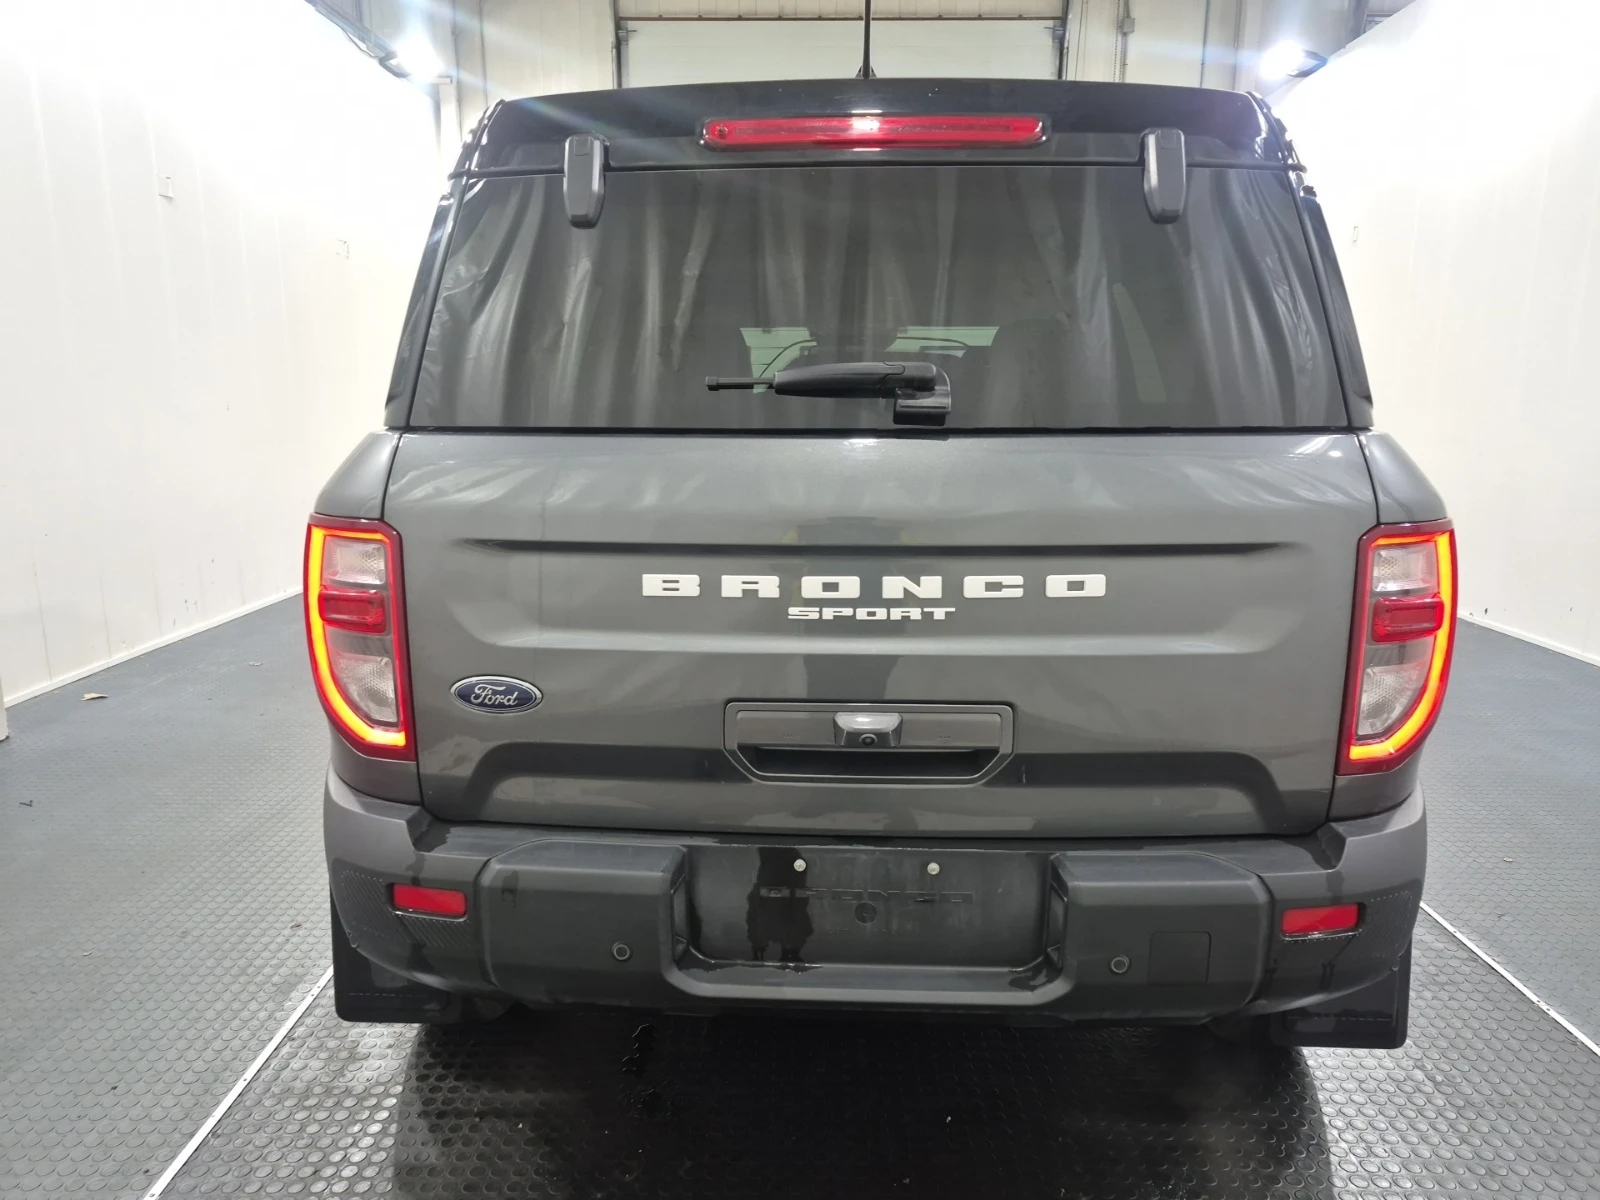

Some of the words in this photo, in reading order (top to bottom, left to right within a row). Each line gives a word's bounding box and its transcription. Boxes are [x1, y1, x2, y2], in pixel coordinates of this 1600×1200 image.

[642, 573, 1107, 599] BRONCO
[788, 606, 956, 621] SPORT
[471, 684, 518, 705] Ford
